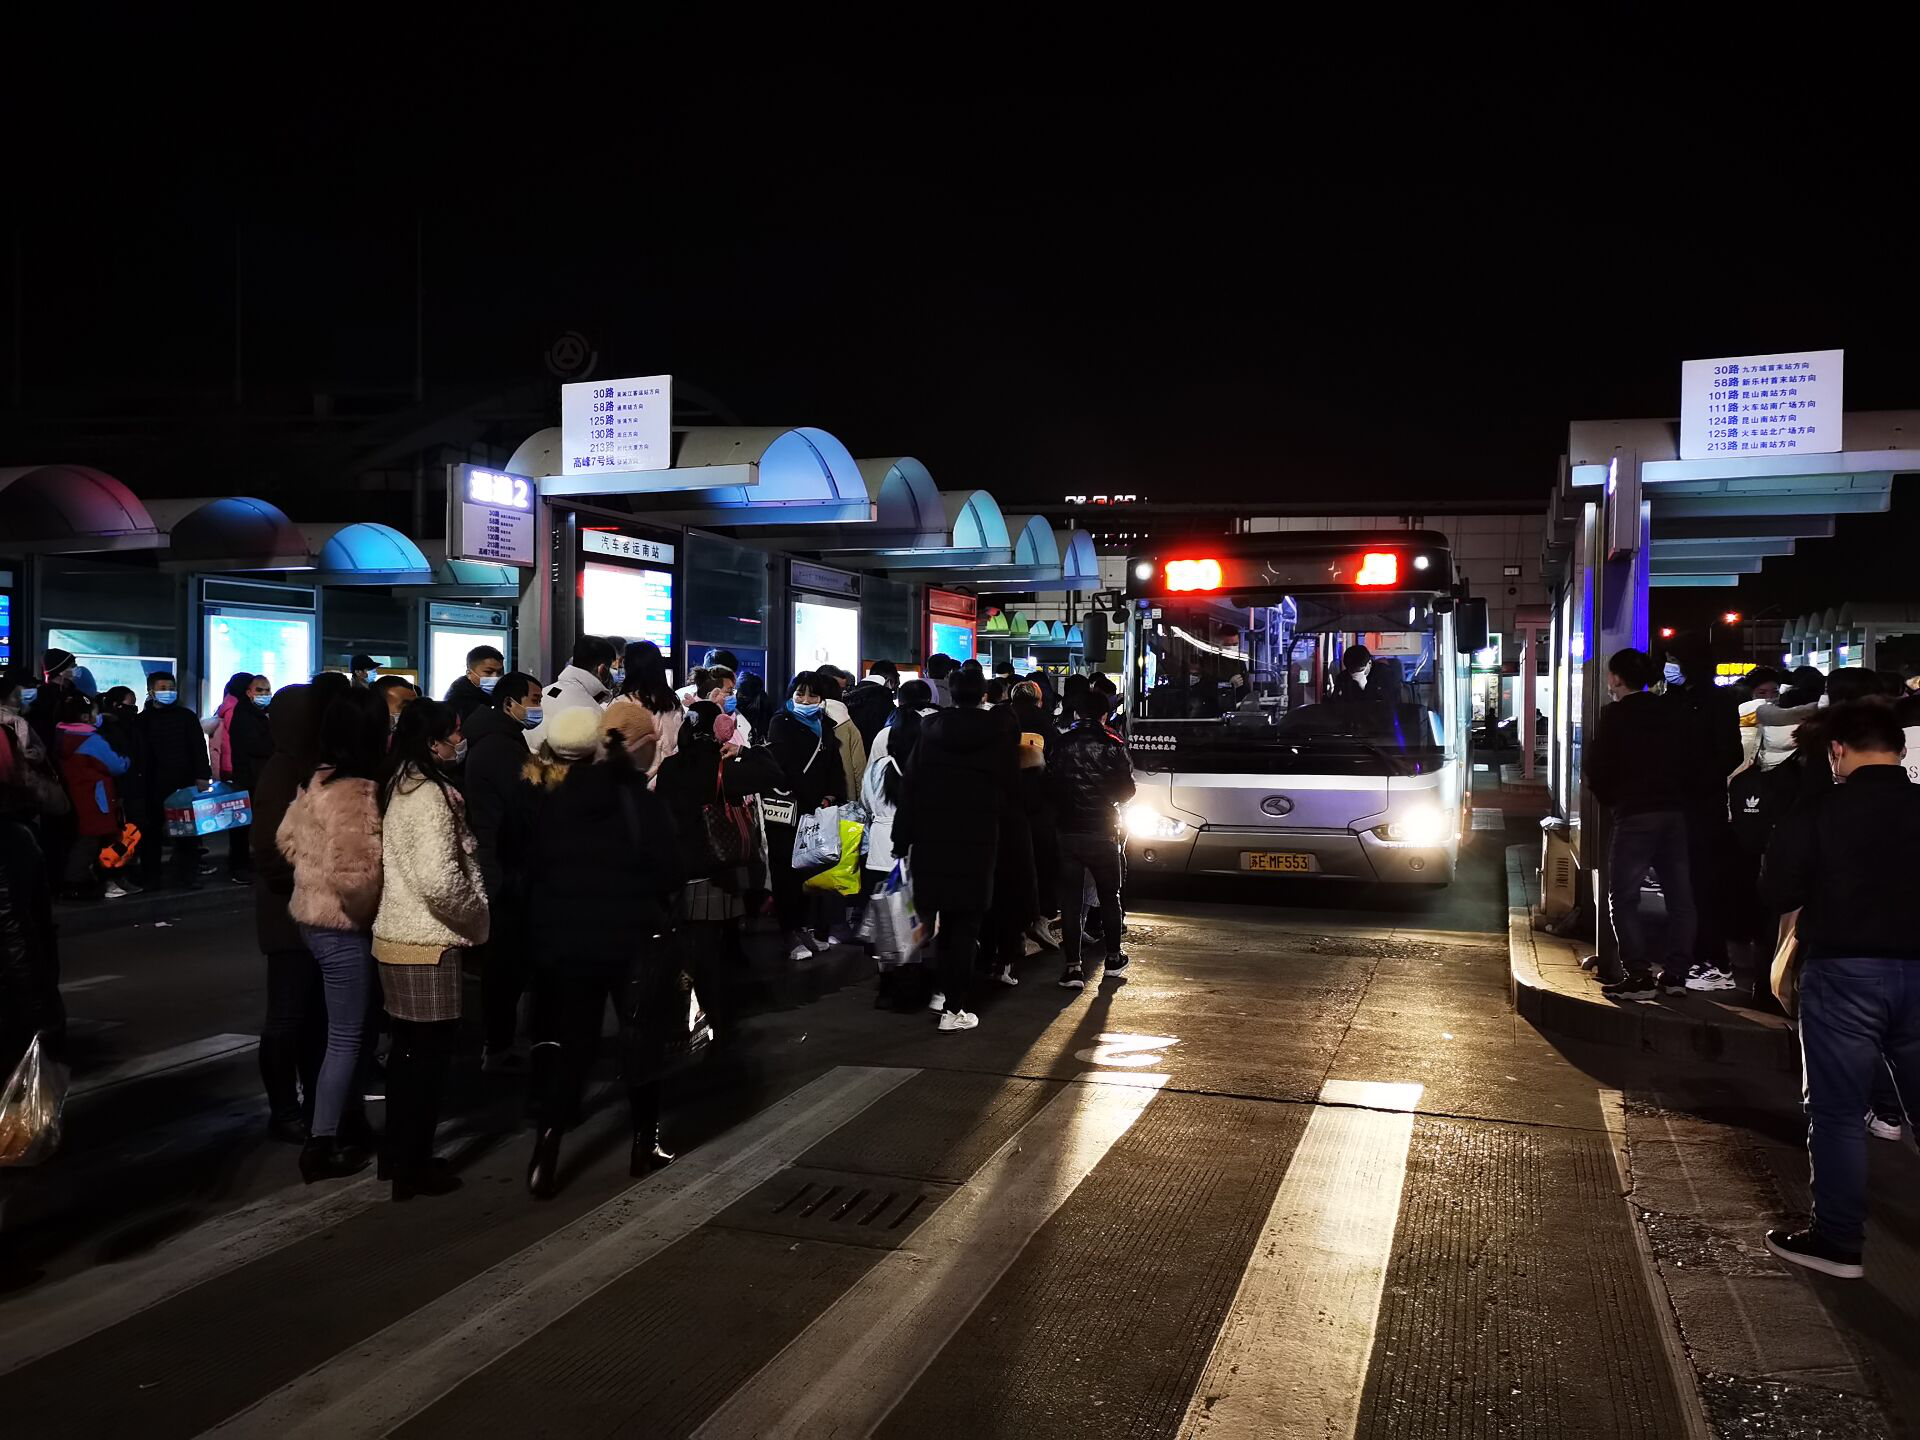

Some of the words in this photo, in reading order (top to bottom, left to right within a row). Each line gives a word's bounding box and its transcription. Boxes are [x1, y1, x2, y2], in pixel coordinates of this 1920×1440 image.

[1714, 364, 1739, 375] 30路
[1714, 377, 1739, 387] 58路
[1742, 374, 1817, 386] 新乐村首末站方向
[593, 387, 614, 399] 30路
[1708, 389, 1739, 400] 101路
[1742, 388, 1797, 399] 昆山南站方向
[593, 401, 614, 412] 58路
[1708, 402, 1739, 413] 111路
[1742, 400, 1816, 412] 火车站南广场方向
[590, 414, 614, 426] 125路
[1708, 415, 1739, 425] 124路
[1742, 414, 1797, 425] 昆山南站方向
[590, 428, 614, 439] 130路
[1708, 428, 1739, 438] 125路
[1741, 426, 1816, 437] 火车站北广场方向
[590, 441, 614, 453] 213路
[1707, 440, 1738, 451] 213路
[1741, 439, 1796, 450] 昆山南站方向
[573, 455, 615, 468] 高峰7号线
[601, 536, 660, 559] 汽车客运南站
